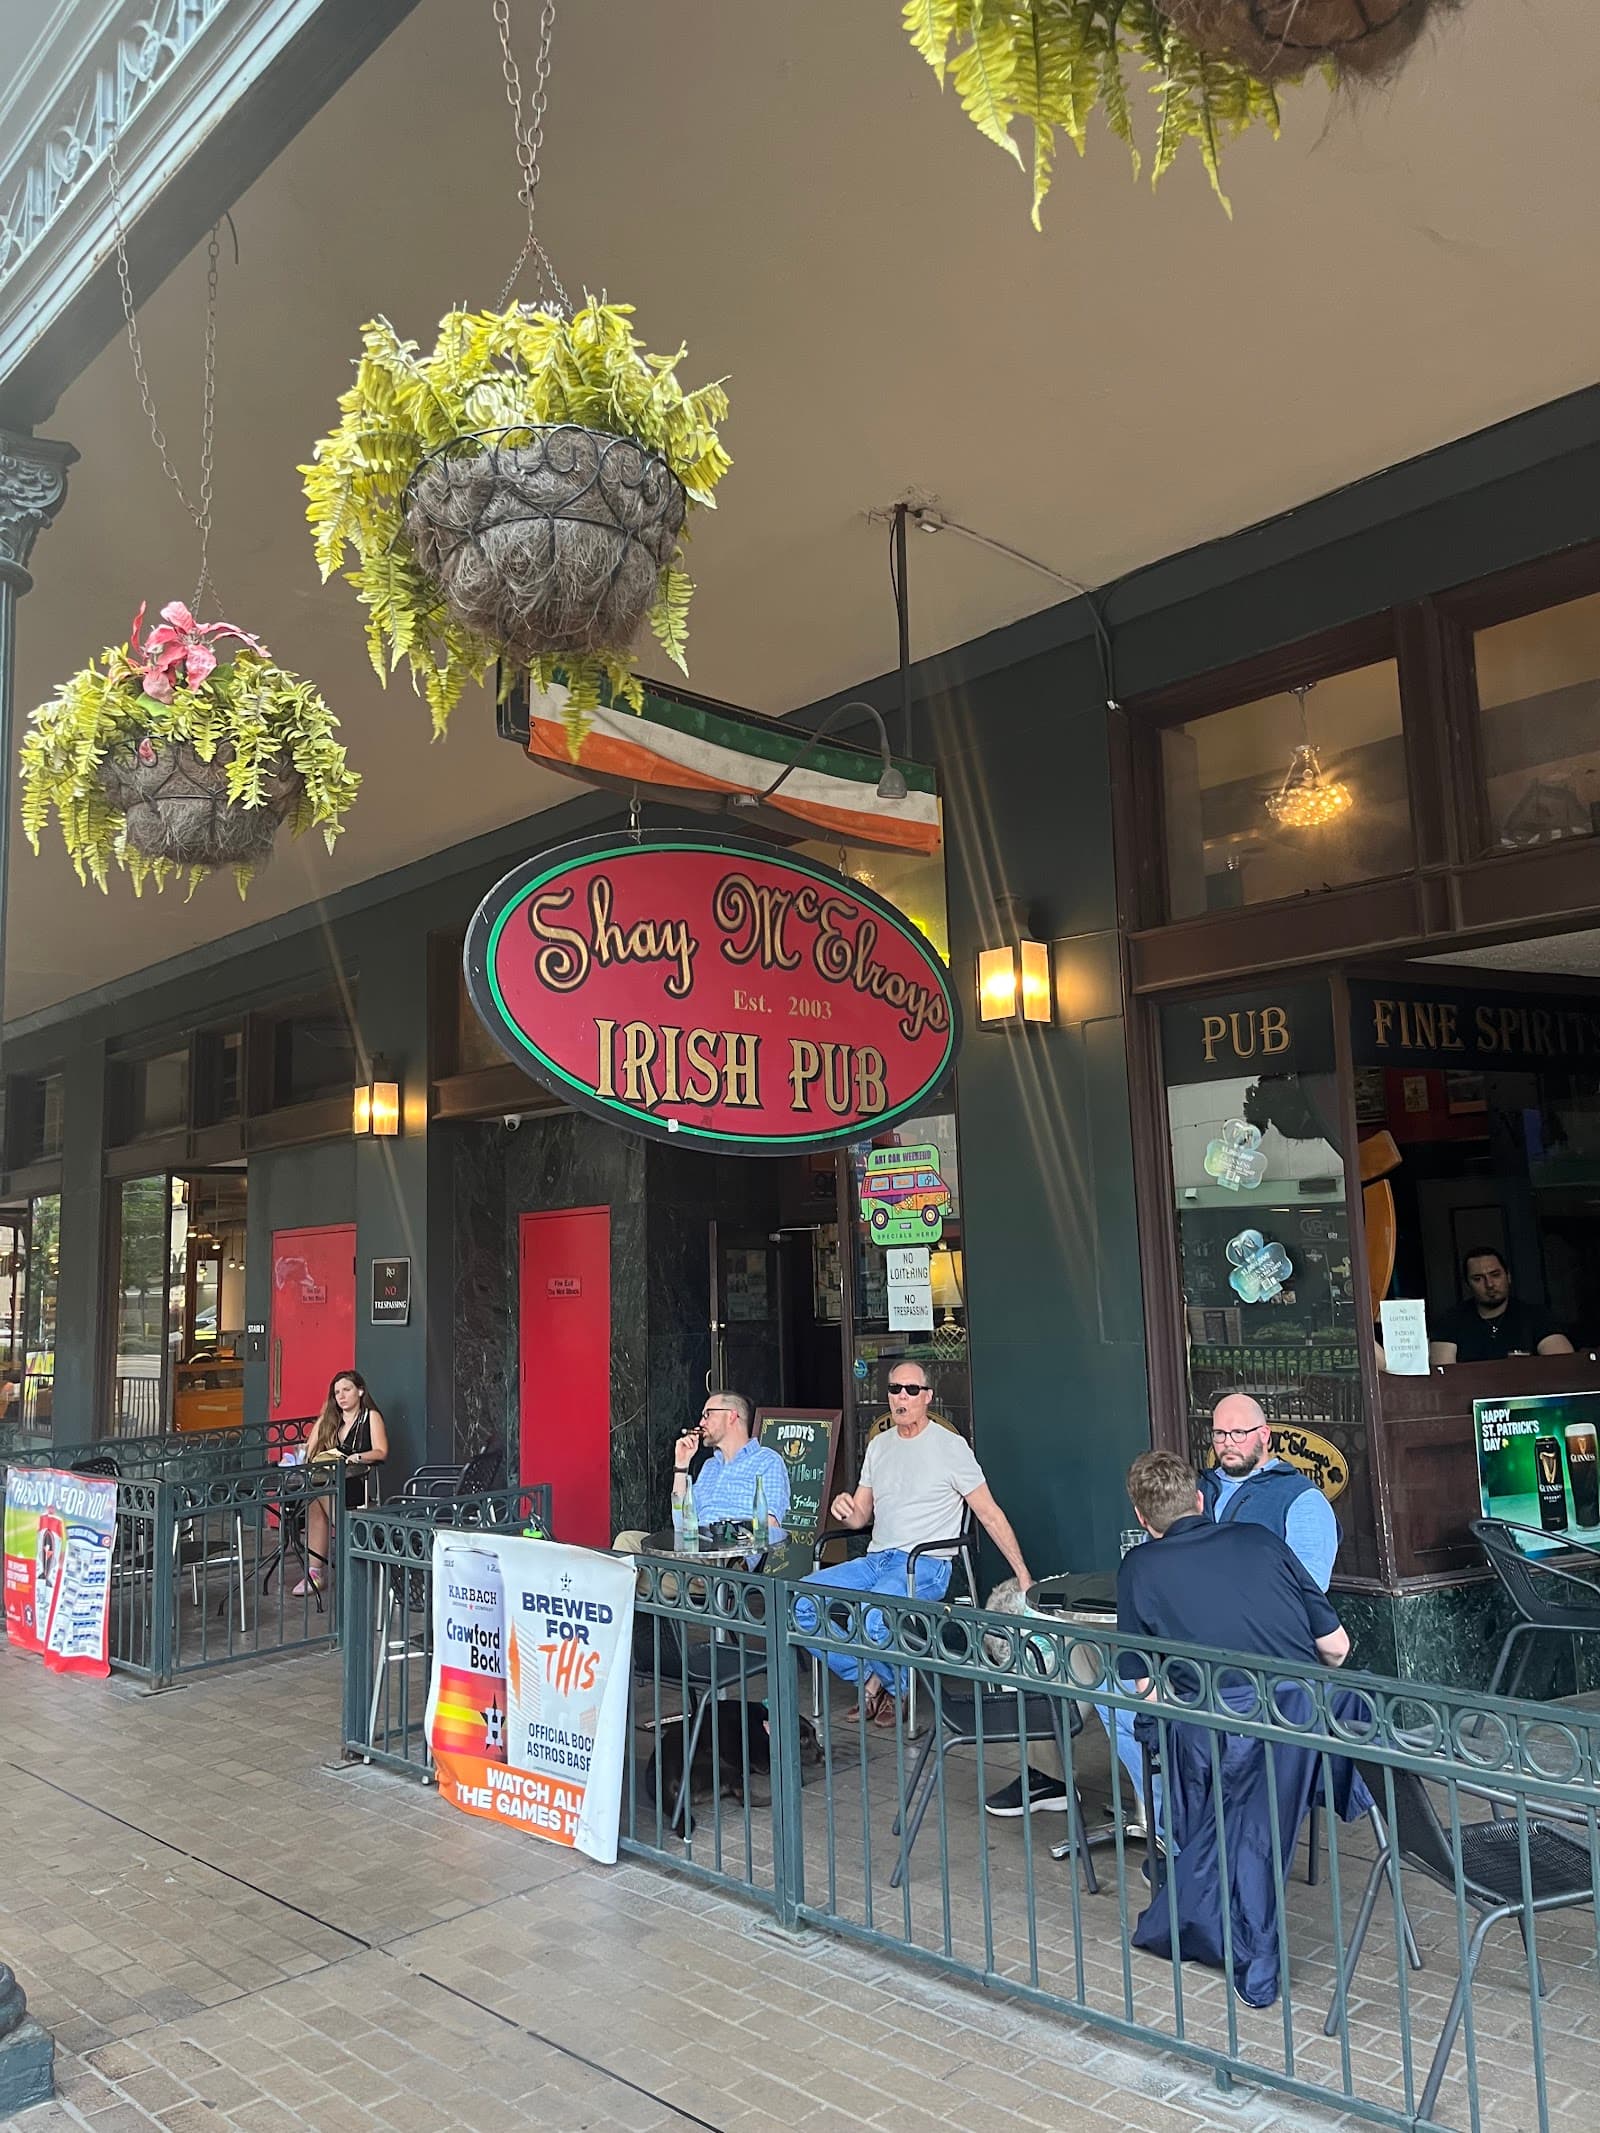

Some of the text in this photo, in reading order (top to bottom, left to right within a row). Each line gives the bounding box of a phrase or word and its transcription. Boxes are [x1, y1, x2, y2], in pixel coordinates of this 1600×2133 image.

[529, 873, 951, 1040] Shay McElroys
[733, 989, 832, 1020] Est. 2003
[1201, 1006, 1291, 1063] PUB
[1373, 1000, 1465, 1051] FINE
[595, 1018, 889, 1116] IRISH PUB
[903, 1253, 914, 1265] NO
[890, 1267, 928, 1283] LOITERING
[385, 1286, 396, 1296] NO
[904, 1294, 916, 1304] NO
[893, 1306, 929, 1316] TRESPASSING
[1481, 1408, 1511, 1424] HAPPY
[777, 1425, 815, 1442] PADDY'S
[1482, 1420, 1540, 1438] ST. PATRICK'S
[1483, 1438, 1501, 1452] DAY
[793, 1494, 820, 1513] Friday
[448, 1585, 497, 1605] KARBACH
[522, 1592, 613, 1624] BREWED
[447, 1617, 501, 1649] Crawford
[546, 1619, 590, 1645] FOR
[471, 1645, 501, 1673] Bock
[536, 1635, 601, 1697] THIS
[528, 1722, 570, 1747] OFFICIAL
[527, 1741, 565, 1765] ASTROS
[486, 1767, 550, 1805] WATCH
[456, 1780, 494, 1810] THE
[496, 1793, 561, 1832] GAMES
